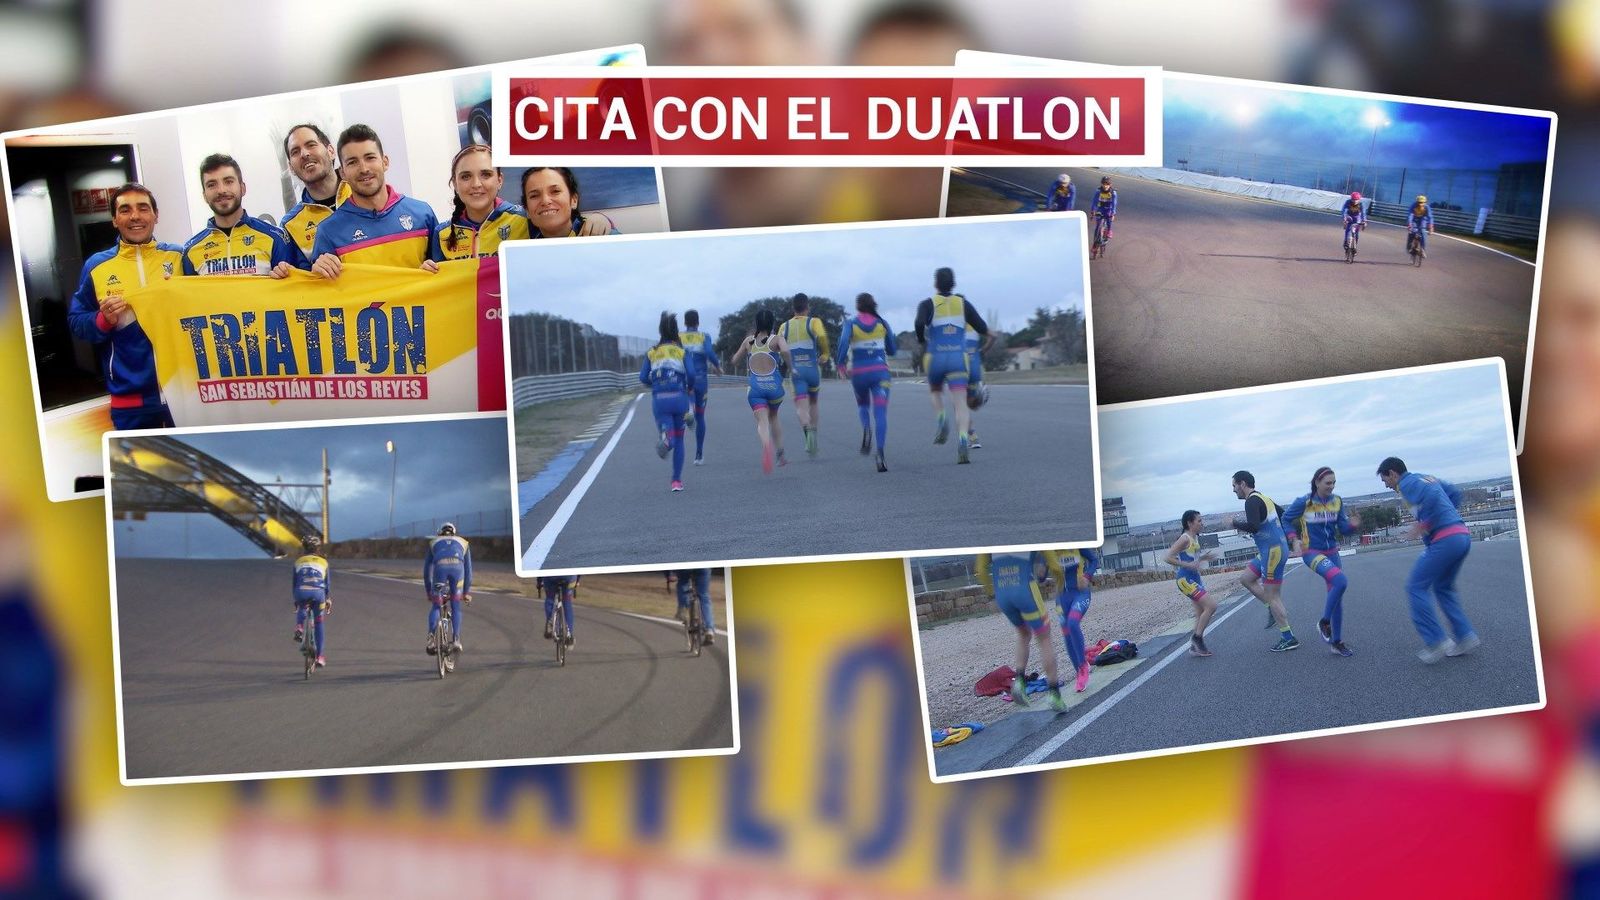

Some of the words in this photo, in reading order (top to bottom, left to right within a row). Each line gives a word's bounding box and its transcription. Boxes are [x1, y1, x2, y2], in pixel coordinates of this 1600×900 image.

[180, 301, 428, 380] TRIATLÓN
[200, 383, 229, 403] SAN
[230, 378, 309, 401] SEBASTIÁN
[315, 381, 335, 399] DE
[337, 380, 368, 398] LOS
[371, 380, 422, 399] REYES
